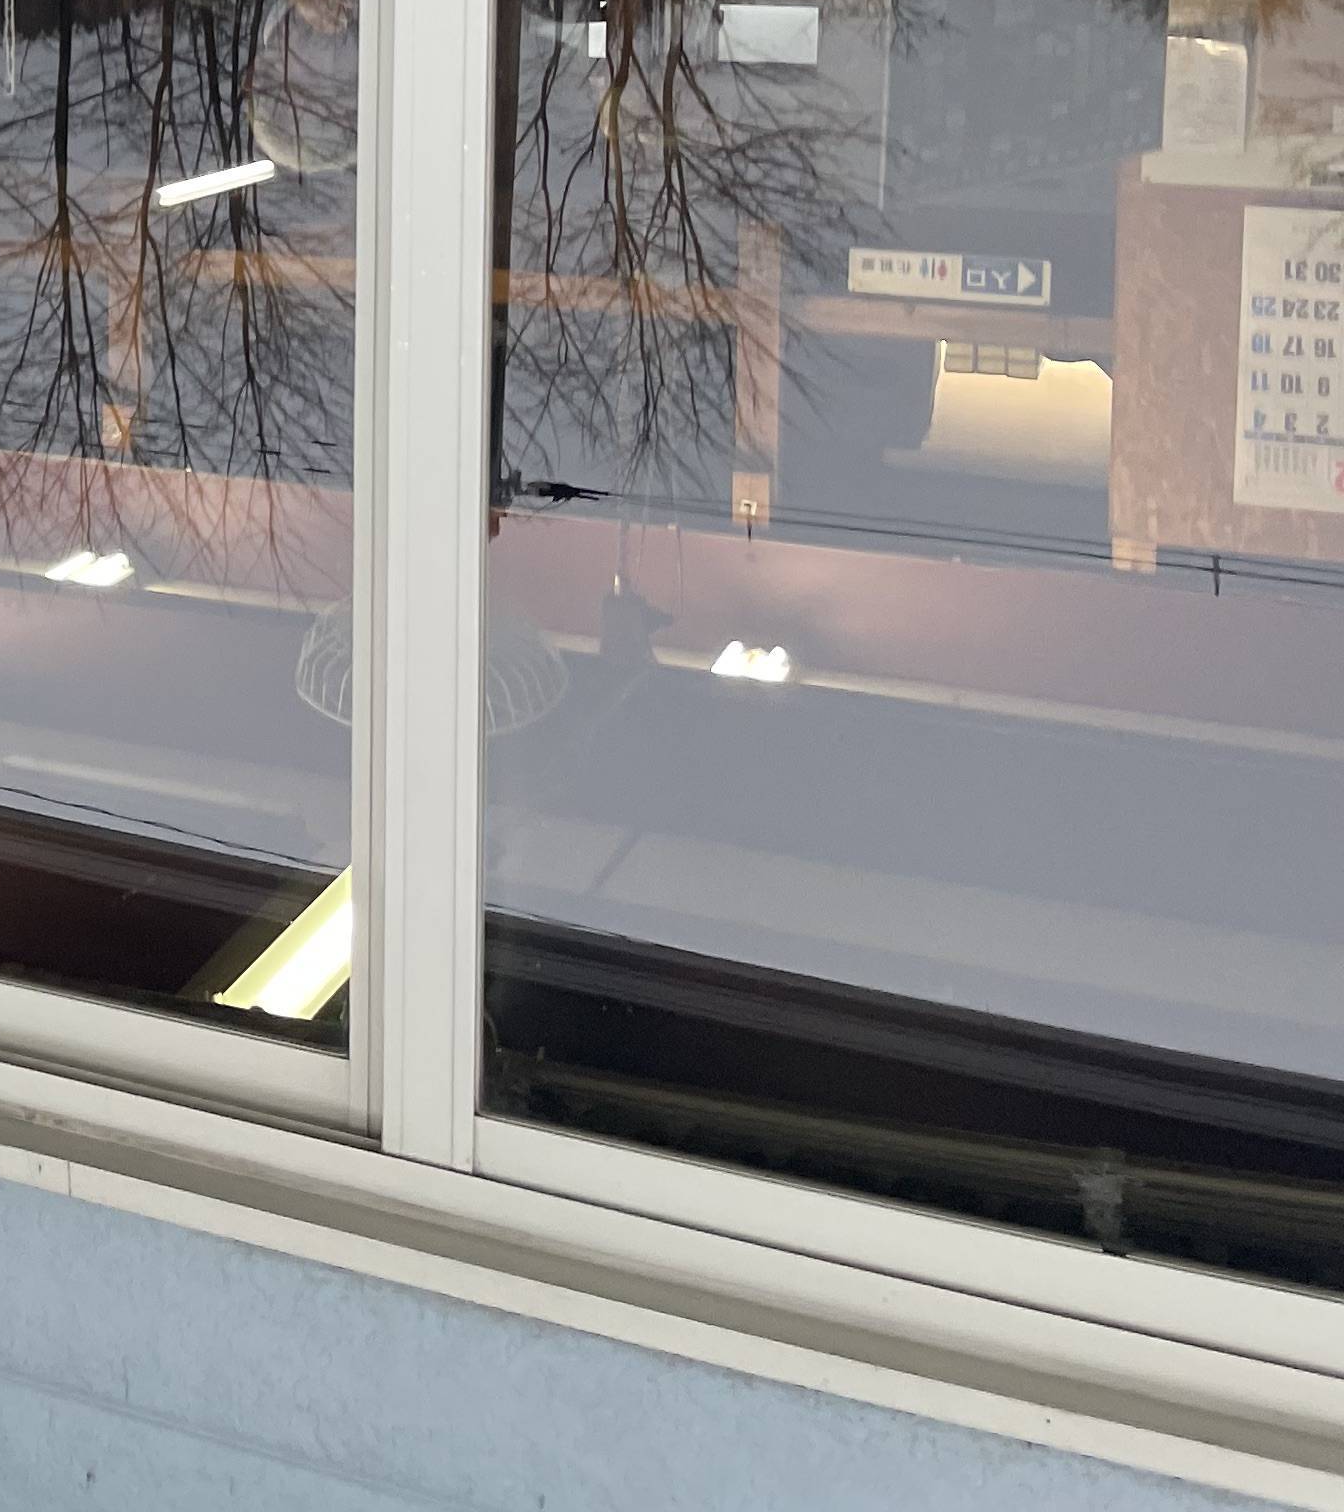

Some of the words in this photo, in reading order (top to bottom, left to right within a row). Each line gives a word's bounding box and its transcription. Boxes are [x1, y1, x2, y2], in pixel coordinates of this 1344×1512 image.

[966, 267, 1012, 290] 入口
[1284, 260, 1308, 281] 31
[1315, 261, 1341, 283] 30
[1251, 295, 1276, 316] 25
[1282, 298, 1309, 319] 24
[1313, 300, 1340, 321] 23
[1282, 335, 1304, 357] 17
[1314, 337, 1336, 359] 16
[1251, 370, 1269, 392] 11
[1280, 373, 1303, 394] 10
[1284, 411, 1297, 432] 3
[1316, 413, 1329, 435] 2
